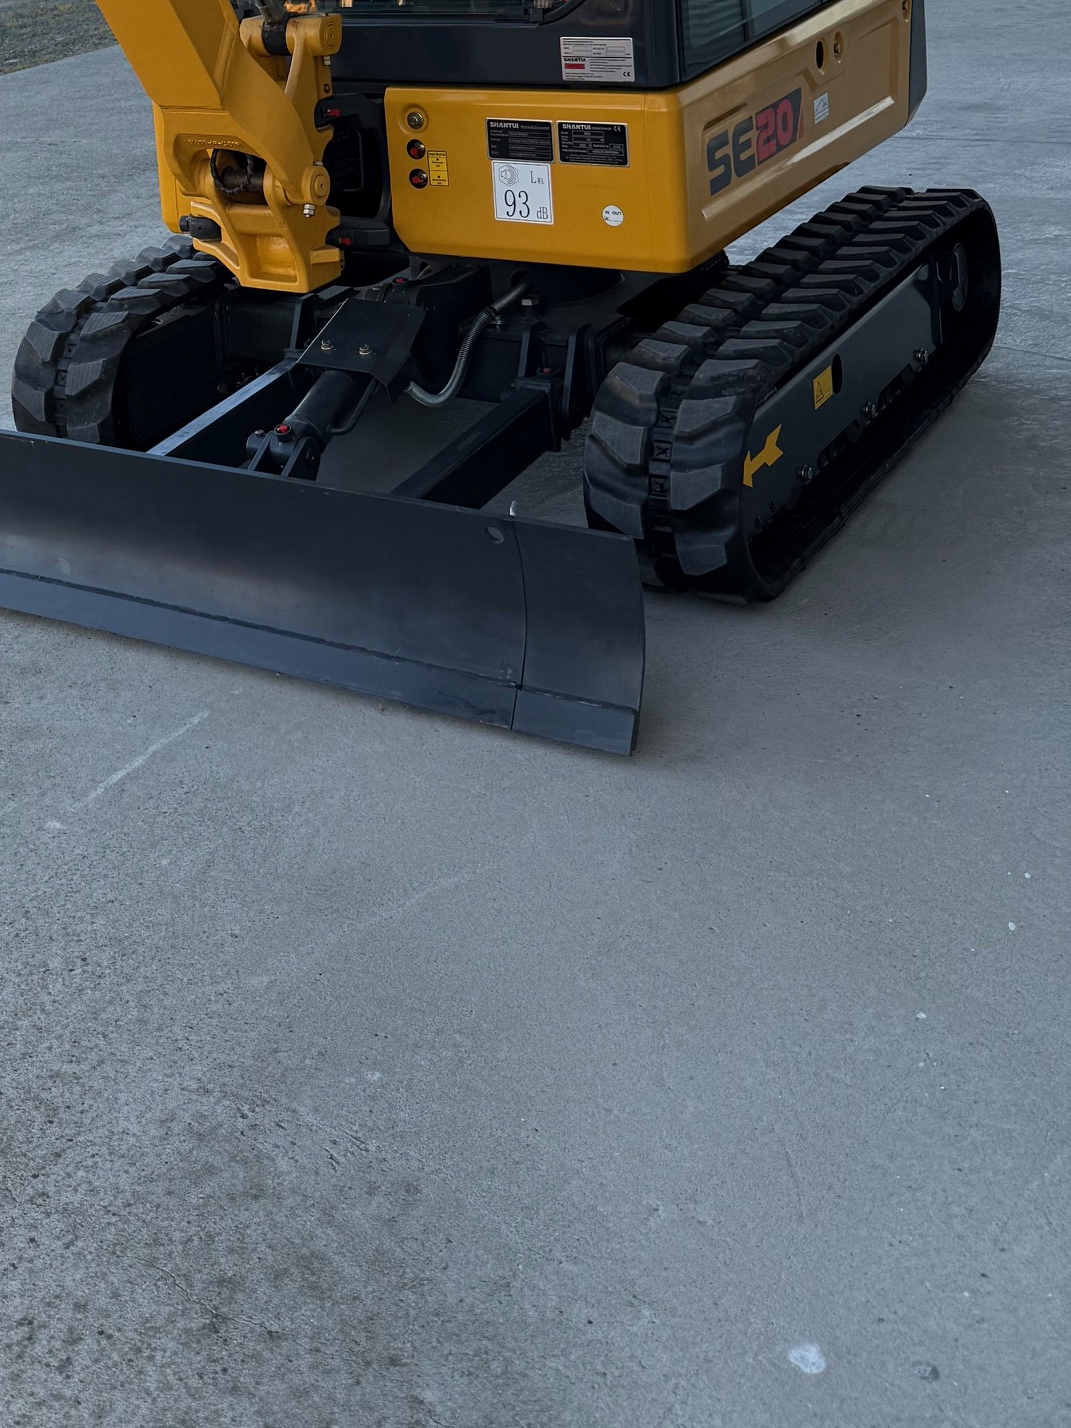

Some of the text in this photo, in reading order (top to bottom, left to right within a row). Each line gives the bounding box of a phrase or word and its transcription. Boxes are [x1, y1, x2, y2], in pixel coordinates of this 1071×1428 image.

[489, 121, 519, 129] SHANTUI
[706, 98, 794, 196] SE20
[504, 189, 531, 219] 93
[536, 206, 549, 220] dB
